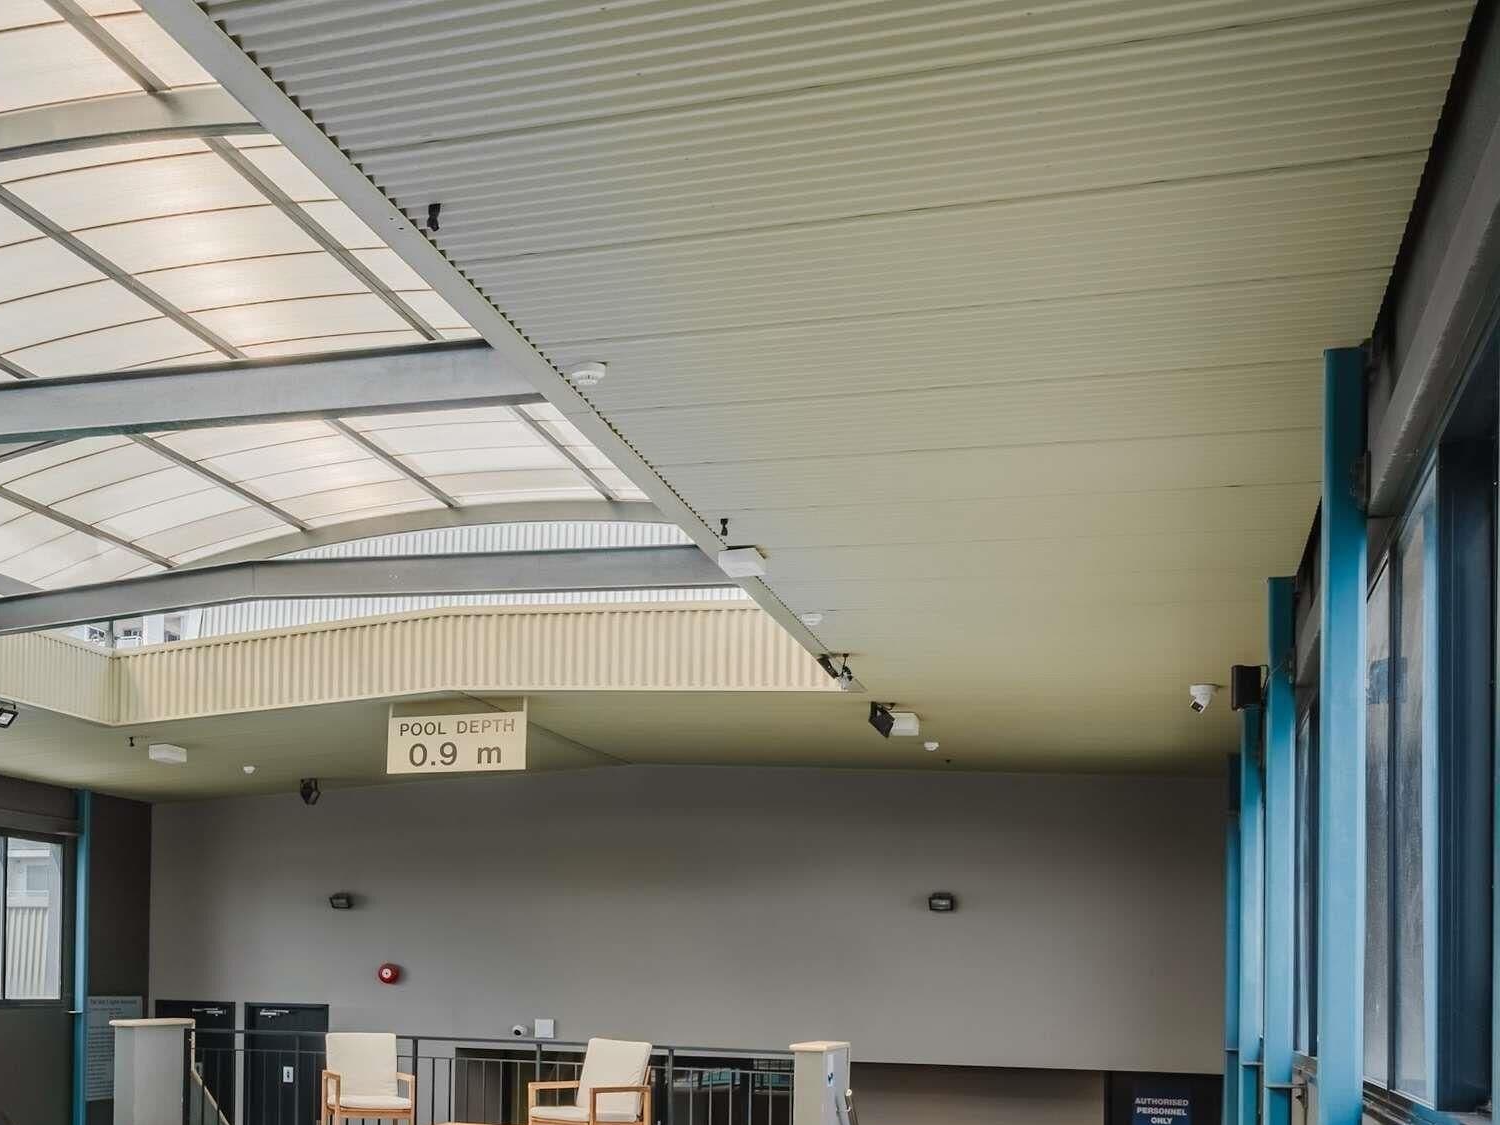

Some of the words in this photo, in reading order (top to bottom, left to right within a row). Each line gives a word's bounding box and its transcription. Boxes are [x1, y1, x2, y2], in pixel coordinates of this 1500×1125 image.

[399, 721, 447, 737] POOL
[457, 718, 515, 734] DEPTH
[409, 741, 458, 767] 0.9
[477, 745, 502, 764] m
[1134, 1097, 1189, 1106] AUTHORISED
[1136, 1107, 1188, 1116] PERSONNEL
[1150, 1117, 1173, 1125] ONLY
